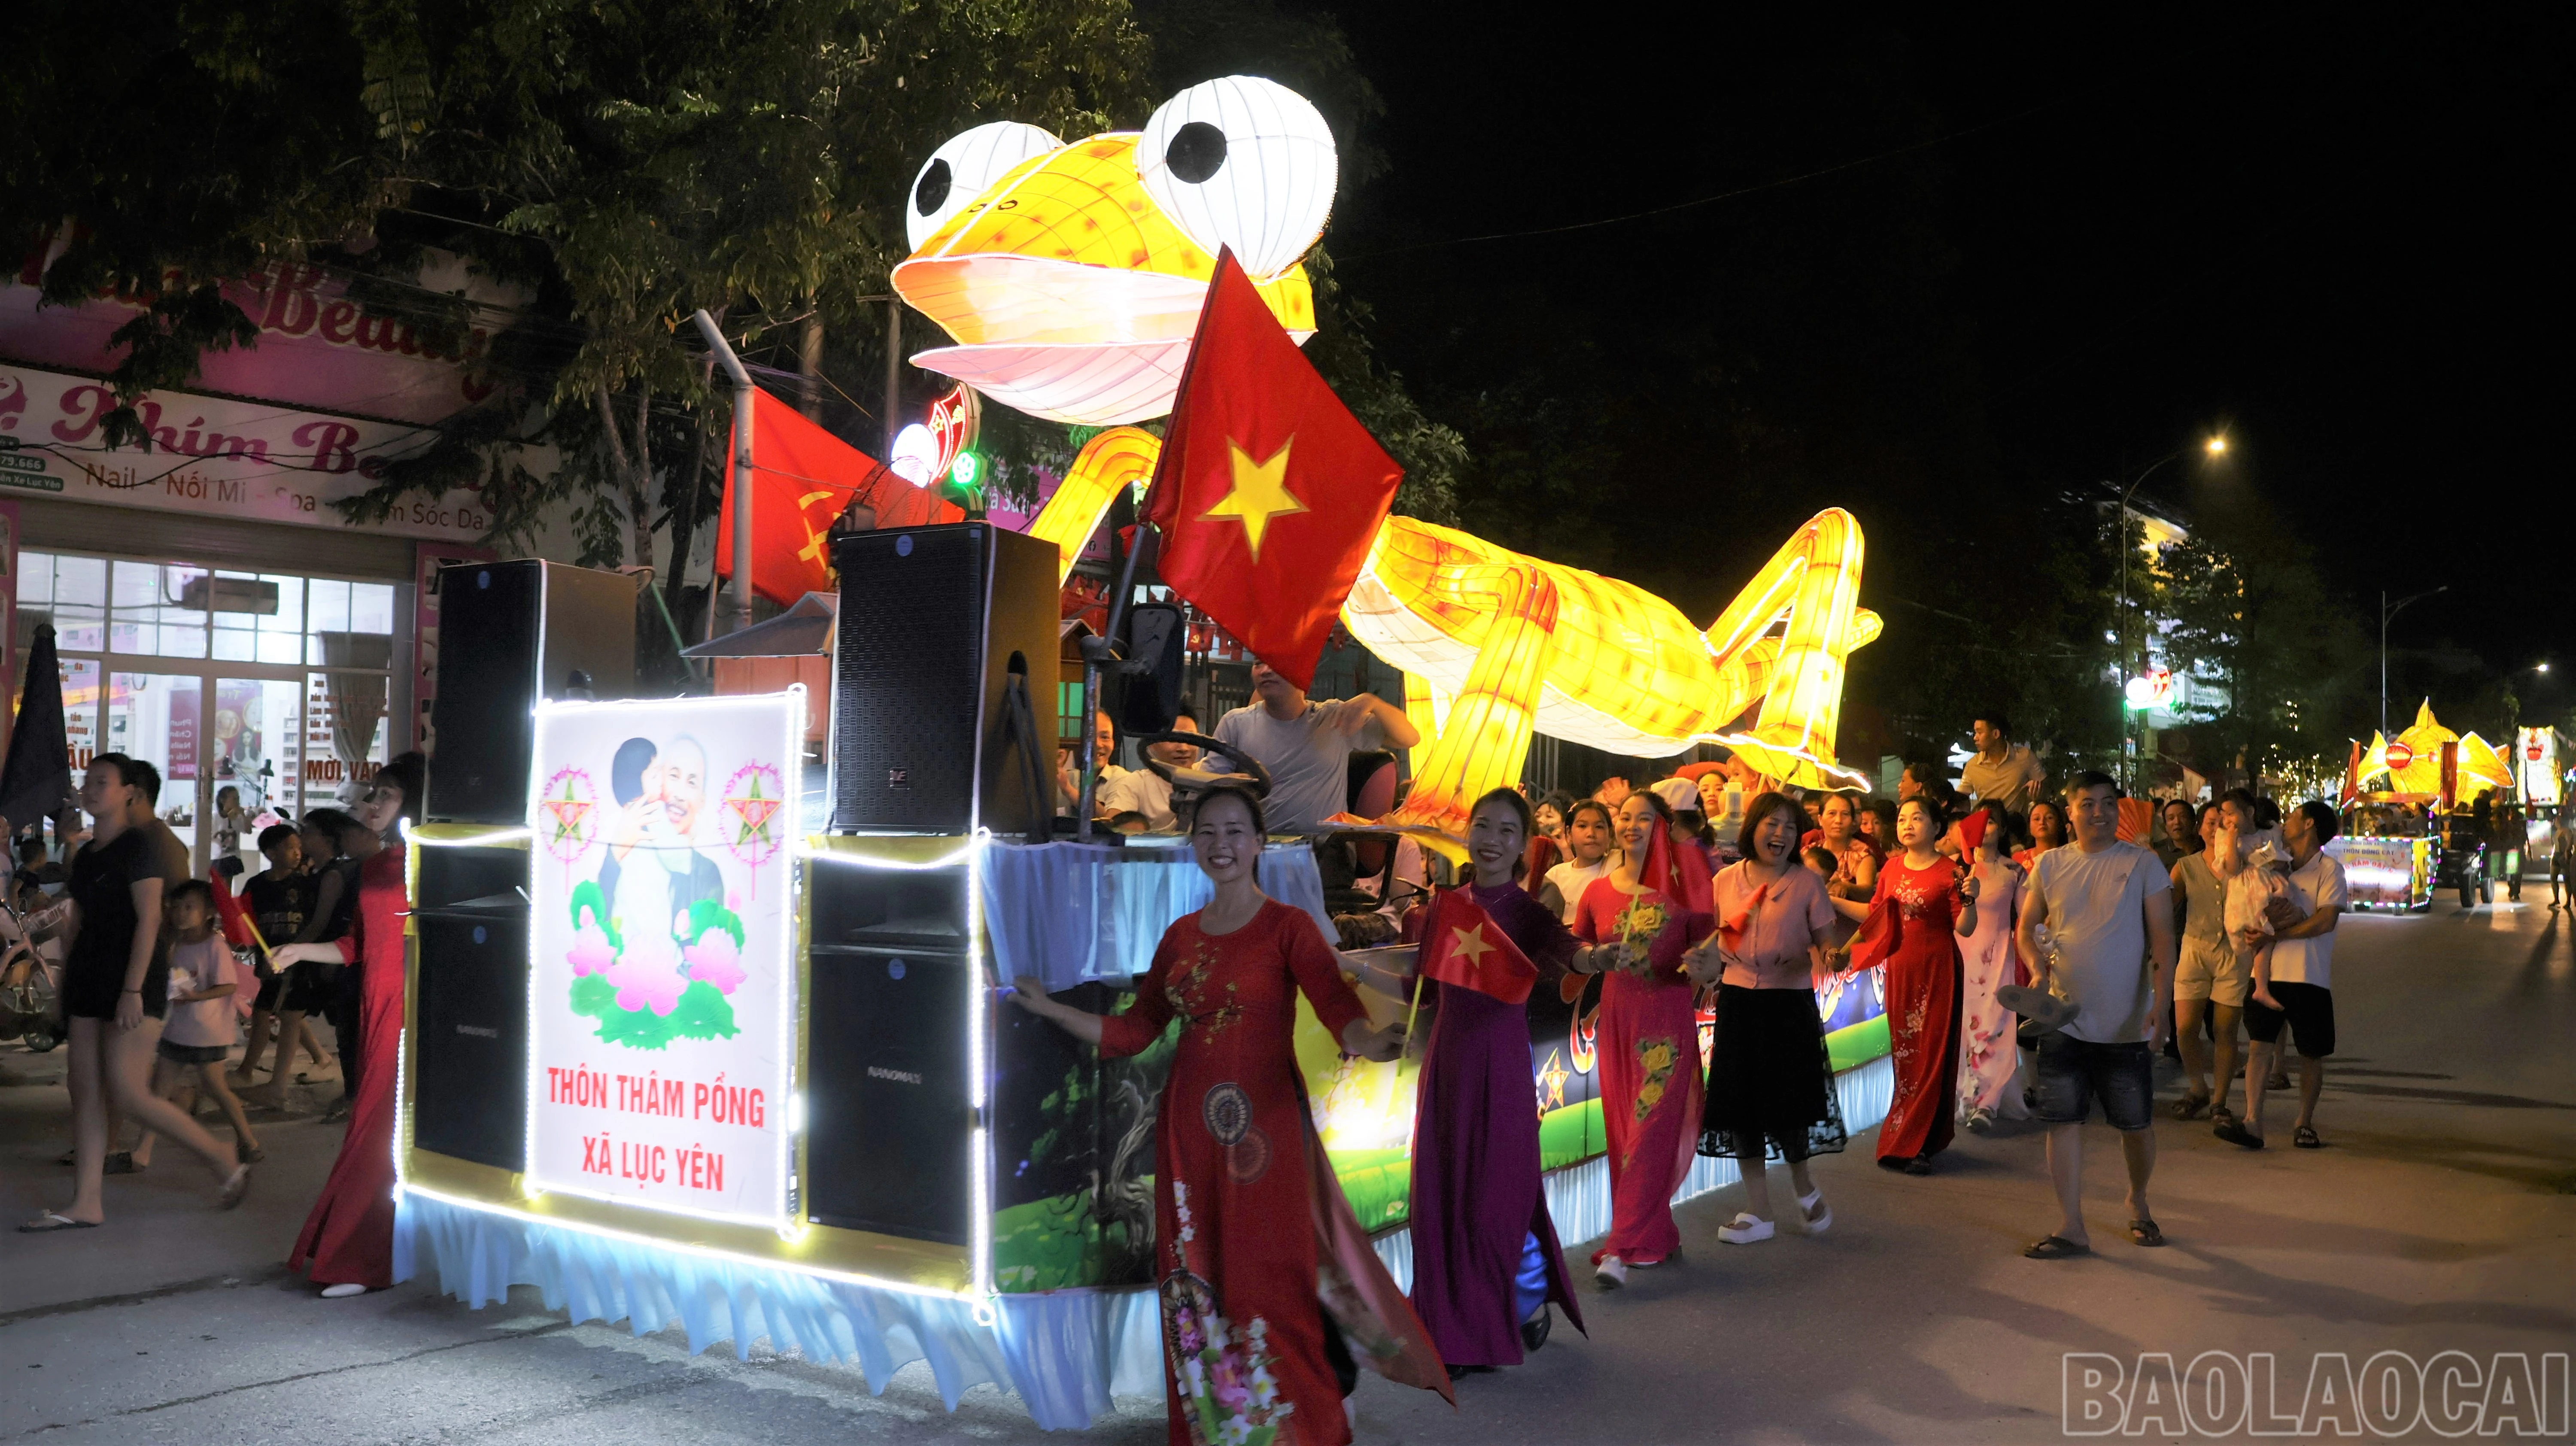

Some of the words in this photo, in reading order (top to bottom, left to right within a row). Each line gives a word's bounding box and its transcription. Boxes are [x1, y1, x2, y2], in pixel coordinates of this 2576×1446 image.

[86, 463, 136, 490] Nail
[166, 471, 207, 499] Nối
[218, 480, 246, 504] Mi
[413, 503, 449, 526] Sóc
[458, 508, 483, 530] Da
[67, 741, 92, 770] ẦU
[307, 754, 341, 780] MỜI
[547, 1063, 608, 1109] THÔN
[617, 1070, 684, 1118] THÂM
[694, 1071, 765, 1128] PỔNG
[582, 1131, 613, 1176] XÃ
[622, 1141, 665, 1189] LỤC
[675, 1142, 723, 1192] YÊN
